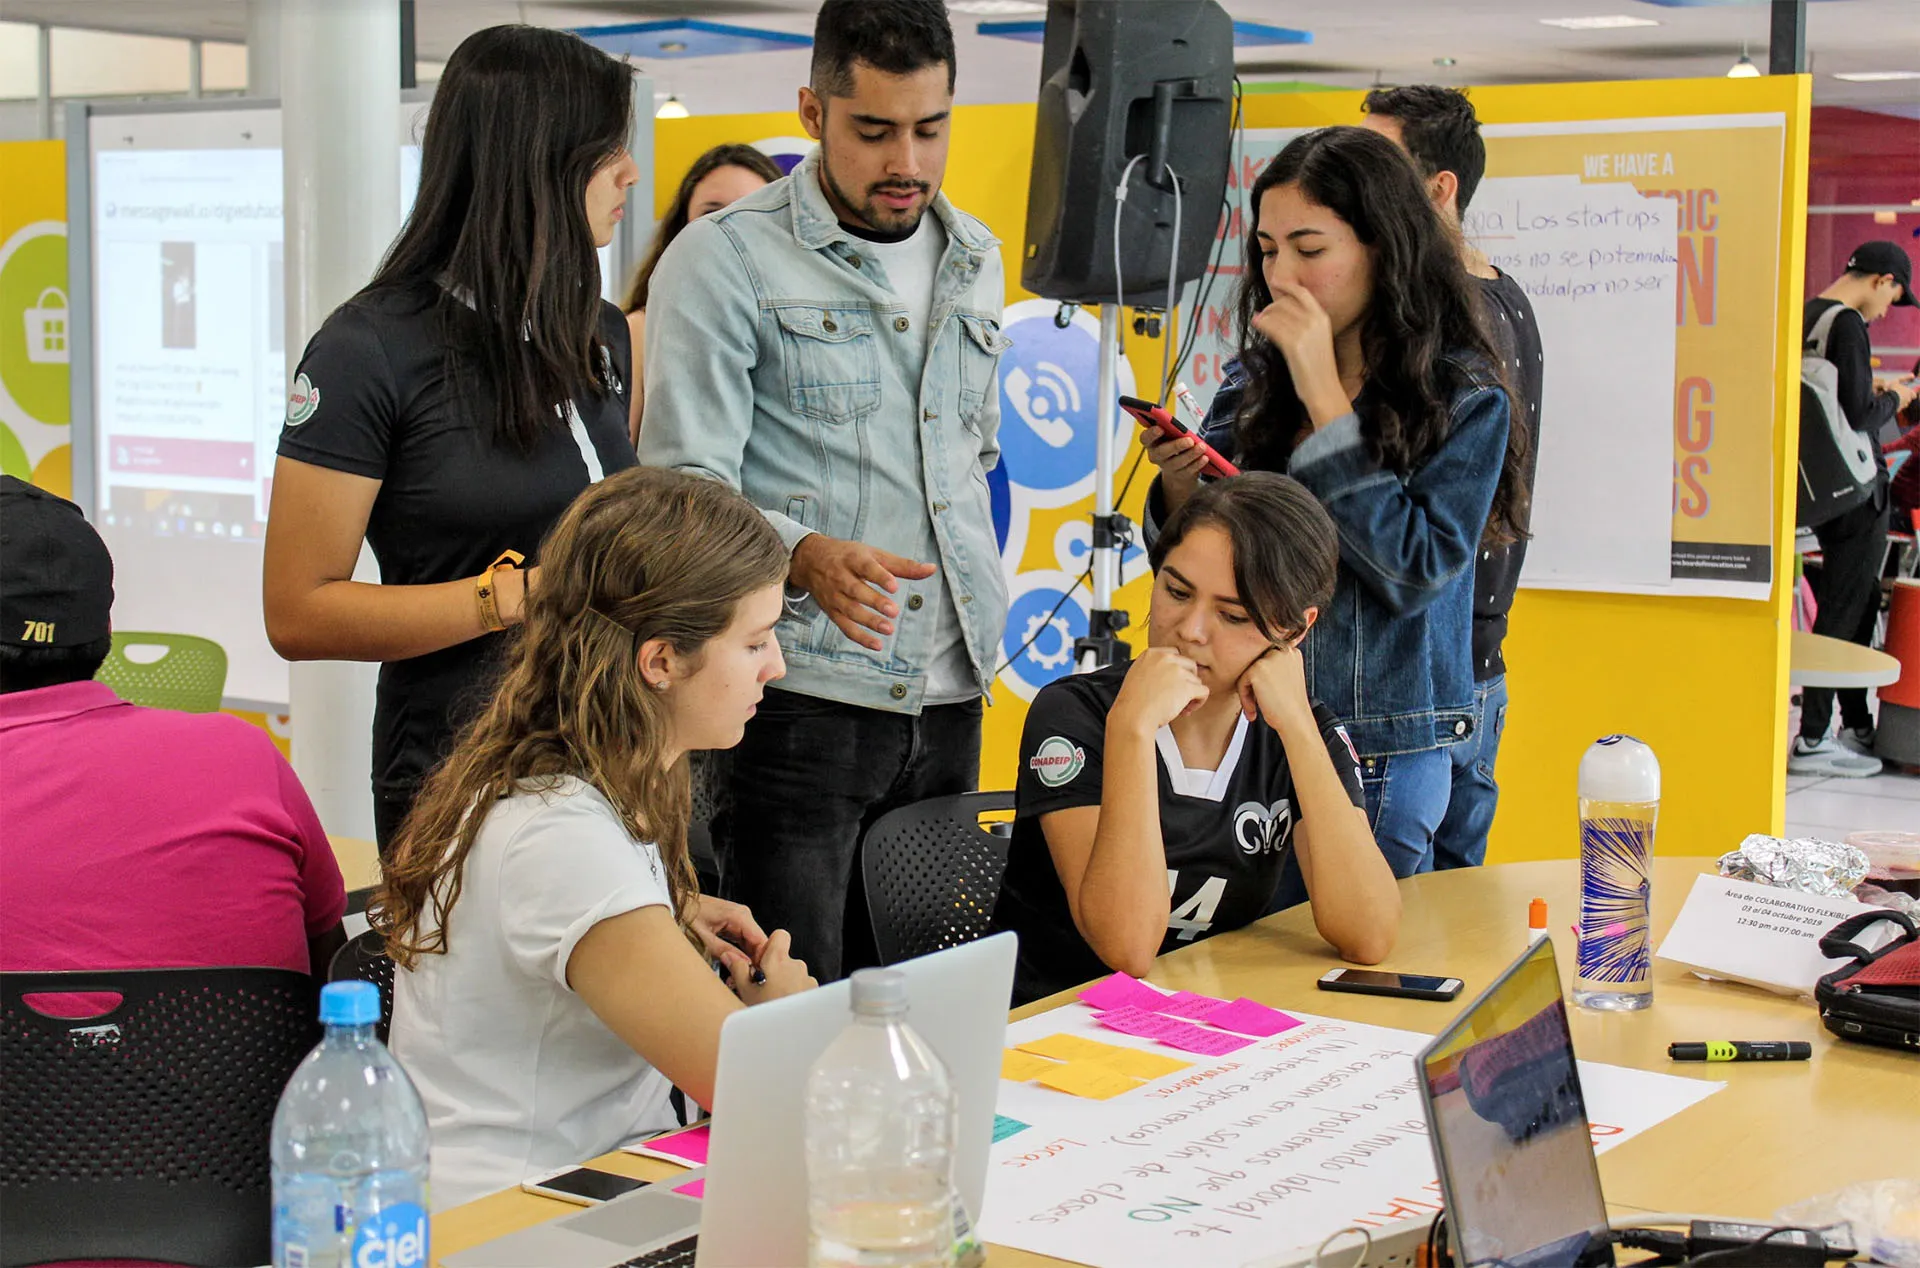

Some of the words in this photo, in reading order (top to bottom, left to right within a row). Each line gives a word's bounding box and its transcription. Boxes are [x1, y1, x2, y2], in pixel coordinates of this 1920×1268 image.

[1583, 153, 1609, 177] WE
[1614, 152, 1659, 176] HAVE
[1662, 152, 1675, 175] A
[1516, 200, 1559, 230] Los
[1529, 251, 1551, 268] no
[1560, 249, 1584, 268] se
[1605, 278, 1629, 295] no
[1671, 560, 1747, 569] ww.boardofinnovation.com
[21, 620, 55, 643] 701
[1031, 756, 1071, 769] CONADEIP
[1741, 904, 1752, 913] 03
[1752, 905, 1761, 914] al
[1761, 907, 1771, 916] 04
[1771, 910, 1802, 924] octubre
[1802, 916, 1823, 927] 2019
[1744, 891, 1754, 902] de
[1755, 895, 1815, 914] COLABORATIVO
[1816, 907, 1850, 921] FLEXIBLE
[1736, 917, 1758, 928] 12:30
[1758, 921, 1772, 931] pm
[1778, 926, 1801, 937] 07:00
[1801, 930, 1815, 939] am
[1369, 1050, 1413, 1061] te
[1250, 1054, 1319, 1083] tienes
[1266, 1099, 1296, 1113] en
[1233, 1113, 1269, 1128] un
[1165, 1127, 1241, 1158] salón
[1245, 1106, 1361, 1166] problemas
[1320, 1133, 1401, 1171] mundo
[1122, 1161, 1171, 1178] de
[1194, 1166, 1247, 1191] que
[1213, 1172, 1341, 1220] laboral
[1127, 1196, 1203, 1222] NO
[1173, 1222, 1232, 1237] te
[357, 1217, 426, 1268] ciel
